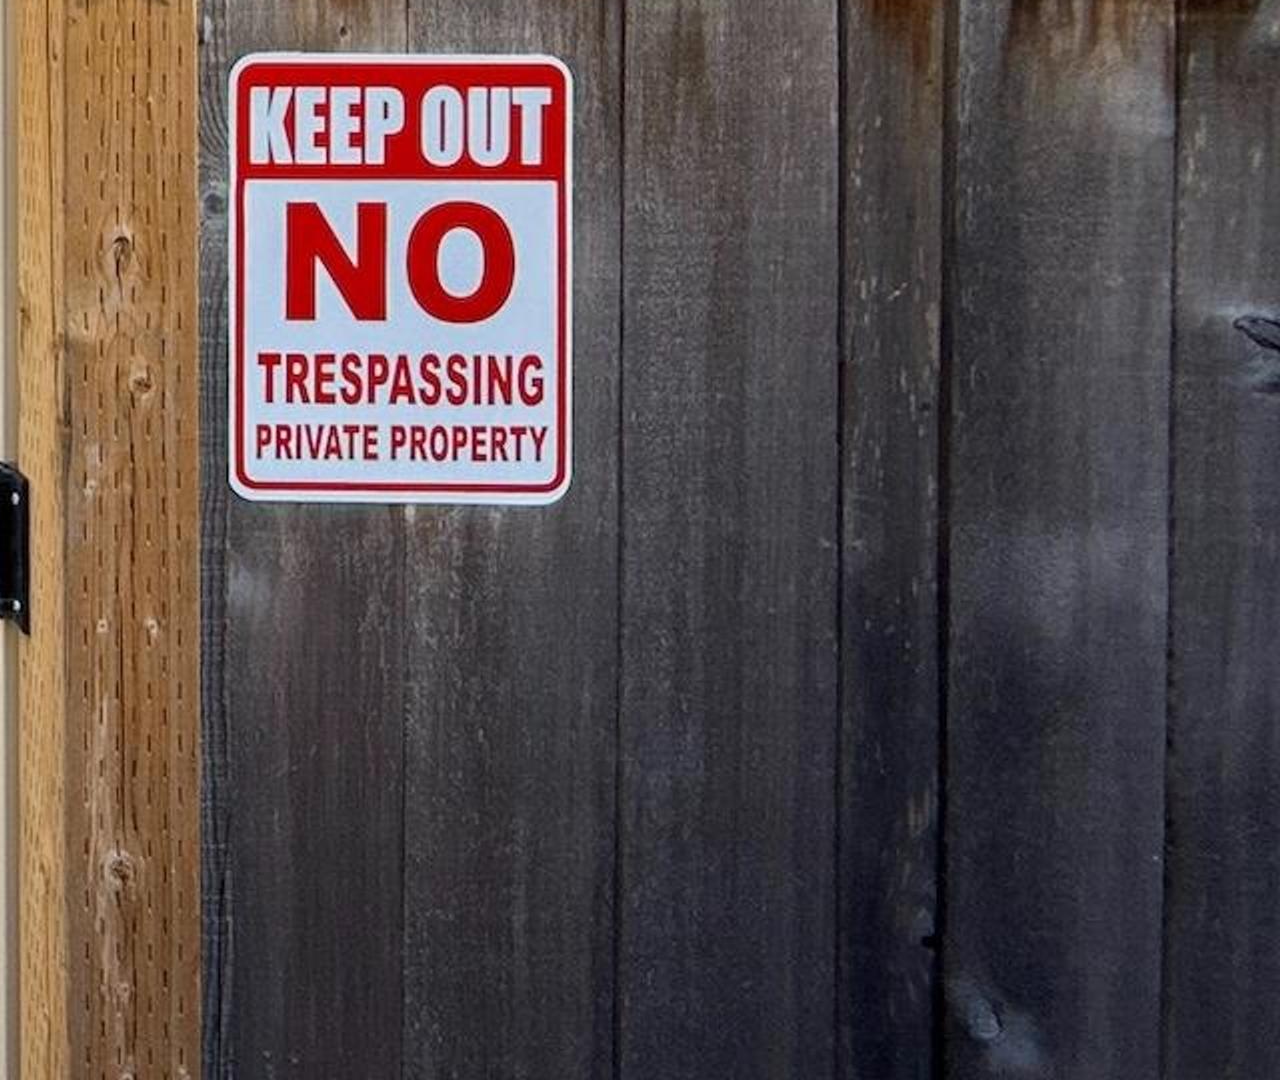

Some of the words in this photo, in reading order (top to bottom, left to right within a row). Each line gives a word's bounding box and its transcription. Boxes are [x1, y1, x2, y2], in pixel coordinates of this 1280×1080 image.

[249, 86, 405, 166] KEEP
[420, 84, 552, 167] OUT
[285, 201, 516, 324] NO
[257, 352, 545, 406] TRESPASSING
[255, 424, 379, 460] PRIVATE
[390, 425, 548, 463] PROPERTY
